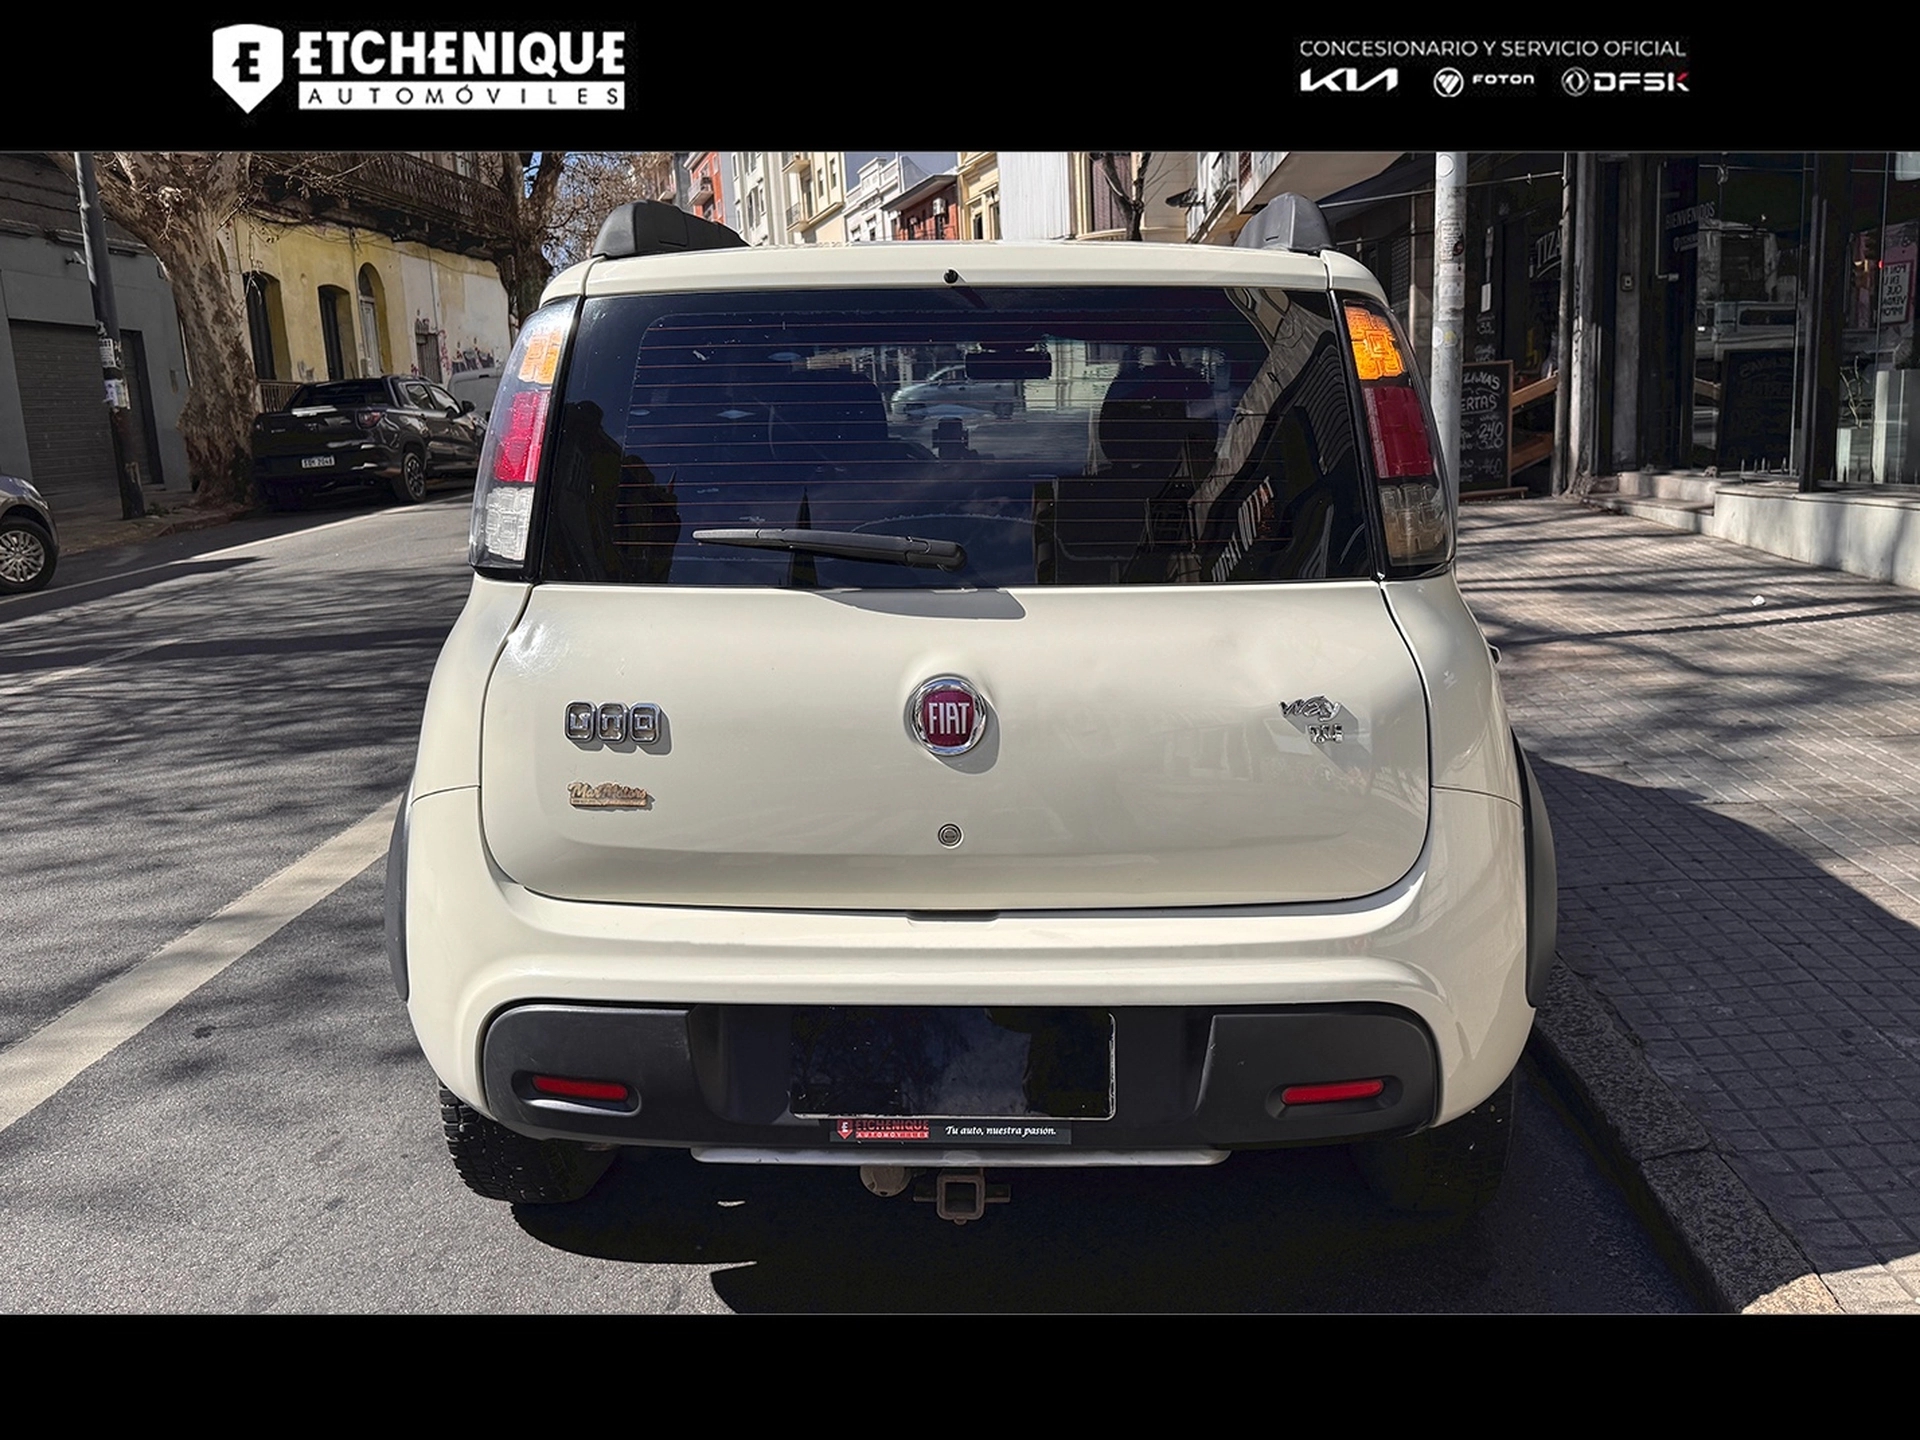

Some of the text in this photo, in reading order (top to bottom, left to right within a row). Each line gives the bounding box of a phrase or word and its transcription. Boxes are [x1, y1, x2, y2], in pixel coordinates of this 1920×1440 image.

[1461, 394, 1497, 412] ERTAS
[928, 702, 970, 735] FIAT
[855, 1120, 929, 1131] ETCHENIQUE
[945, 1125, 959, 1135] Tu
[960, 1126, 984, 1136] auto,
[986, 1126, 1022, 1135] nuestra
